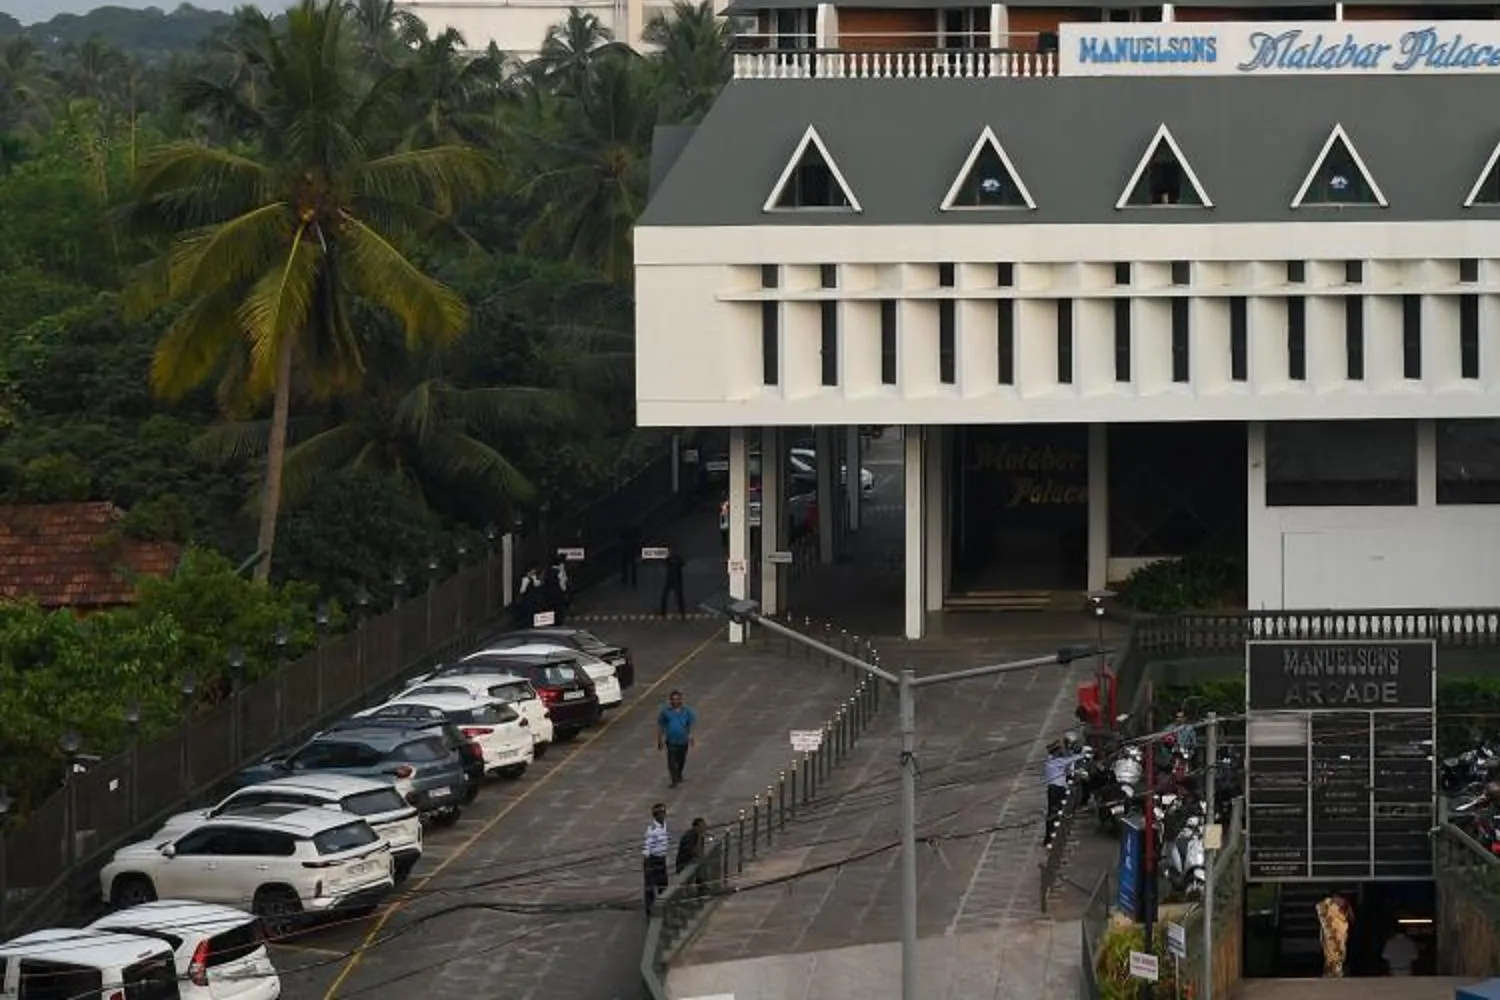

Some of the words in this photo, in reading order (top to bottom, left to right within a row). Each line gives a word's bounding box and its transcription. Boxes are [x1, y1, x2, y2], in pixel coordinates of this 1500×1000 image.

[1079, 36, 1217, 63] MANUELSONS
[1237, 28, 1392, 71] Malabar
[1284, 648, 1400, 675] MANUELSONS
[1285, 682, 1399, 703] ARCADE
